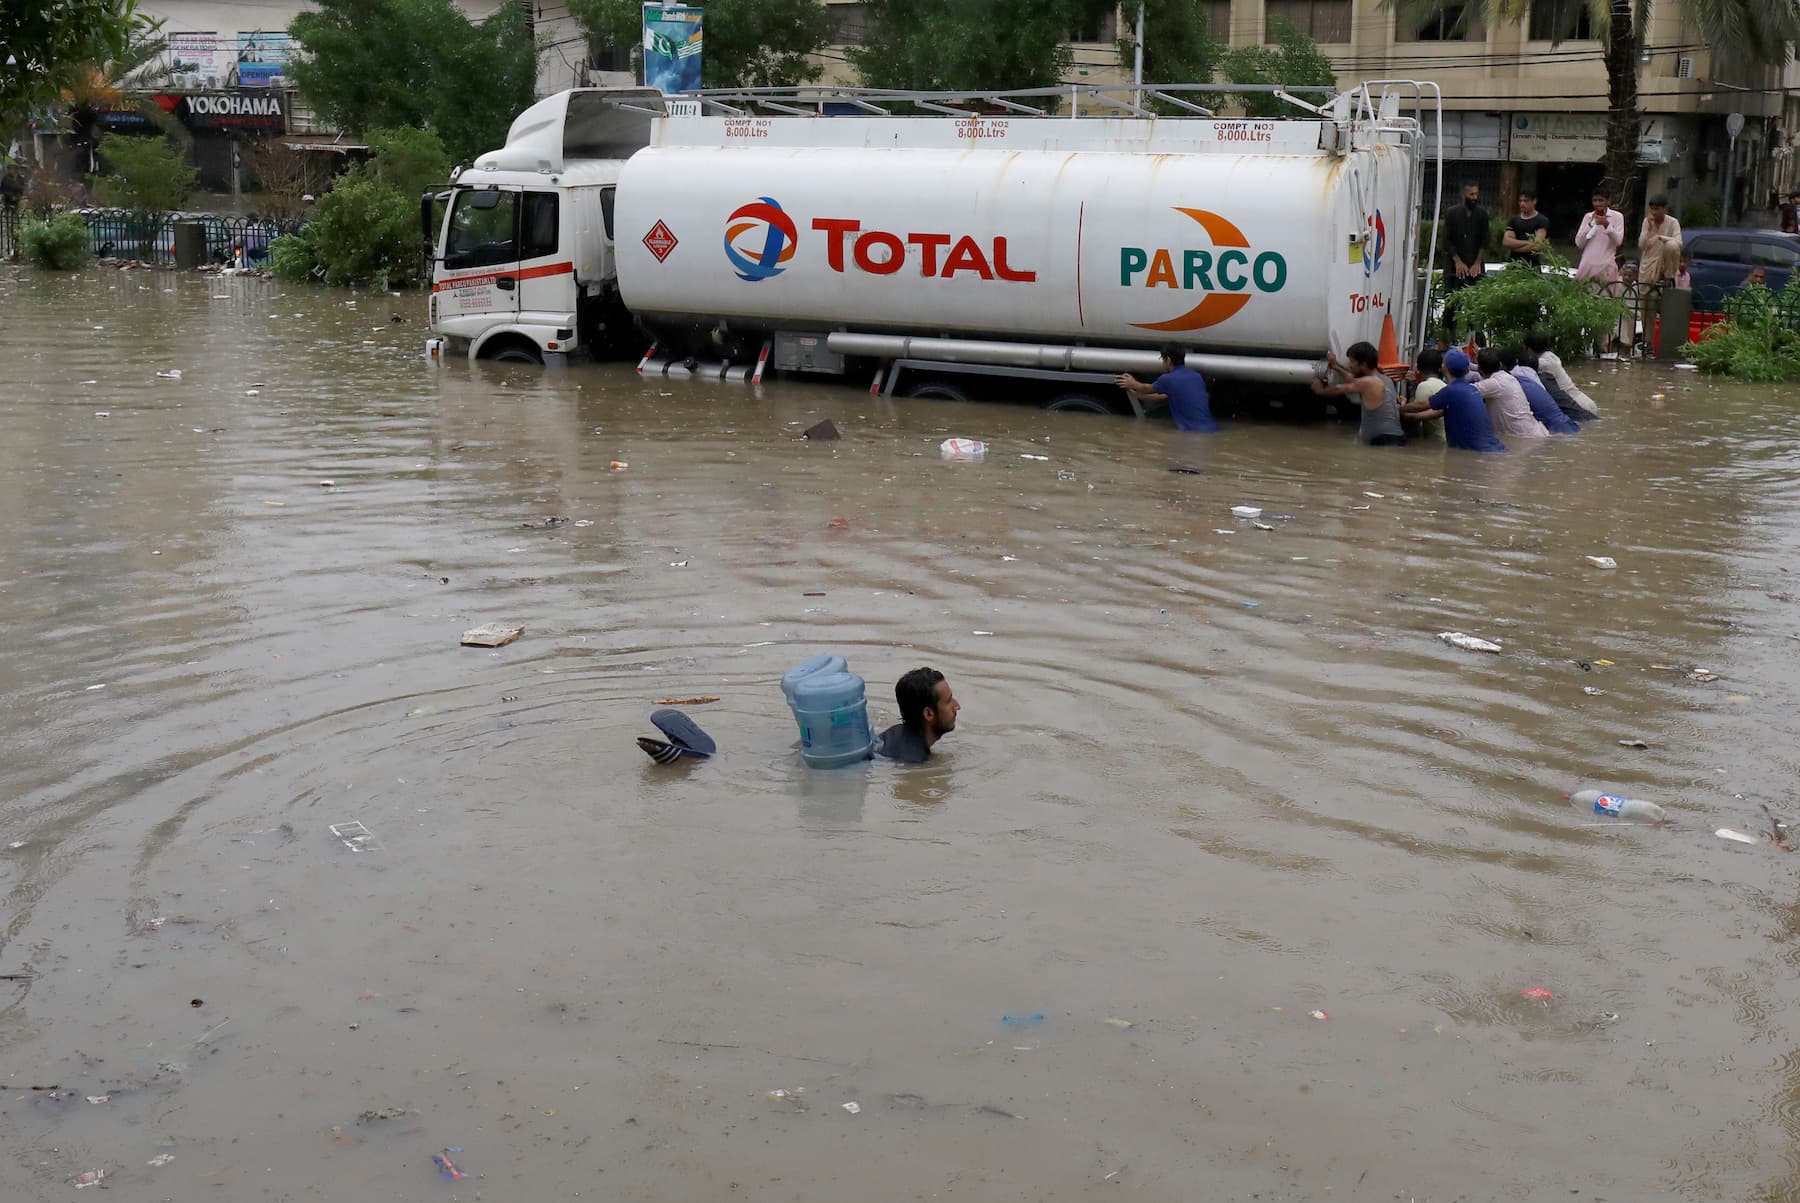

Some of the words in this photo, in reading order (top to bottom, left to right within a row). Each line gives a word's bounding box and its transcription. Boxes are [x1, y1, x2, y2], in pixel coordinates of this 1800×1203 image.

[186, 95, 282, 116] YOKOHAMA
[724, 119, 752, 127] COMPT
[954, 120, 986, 128] COMPT
[991, 120, 1009, 129] NO2
[1213, 123, 1248, 131] COMPT
[1254, 123, 1275, 131] NO3
[811, 217, 1037, 284] TOTAL
[1120, 246, 1288, 294] PARCO
